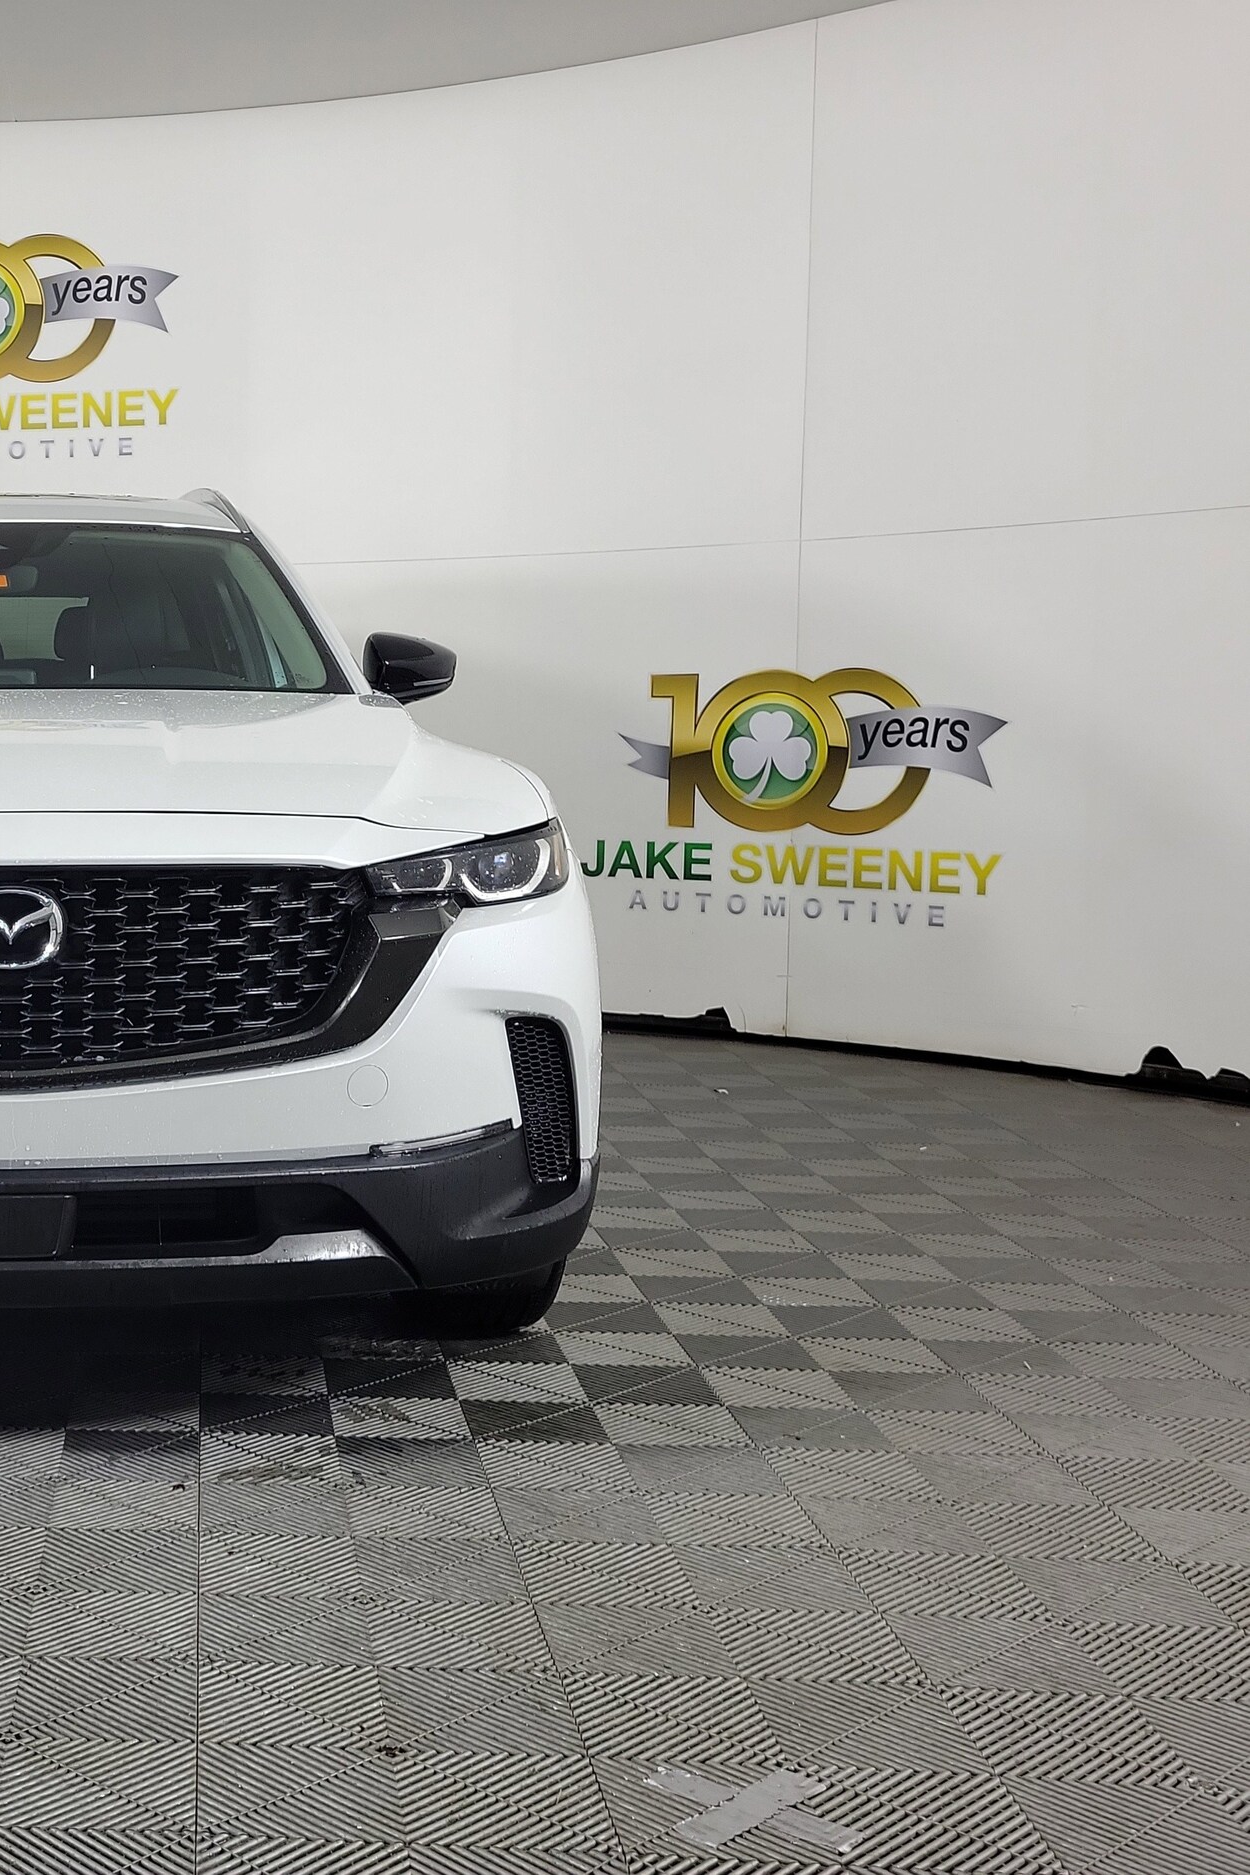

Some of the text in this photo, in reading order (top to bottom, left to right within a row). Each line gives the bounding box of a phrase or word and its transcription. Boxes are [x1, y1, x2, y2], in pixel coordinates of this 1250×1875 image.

[51, 274, 148, 316] years
[650, 667, 970, 836] 100 years
[581, 839, 1002, 896] JAKE SWEENEY
[629, 890, 945, 927] AUTOMOTIVE
